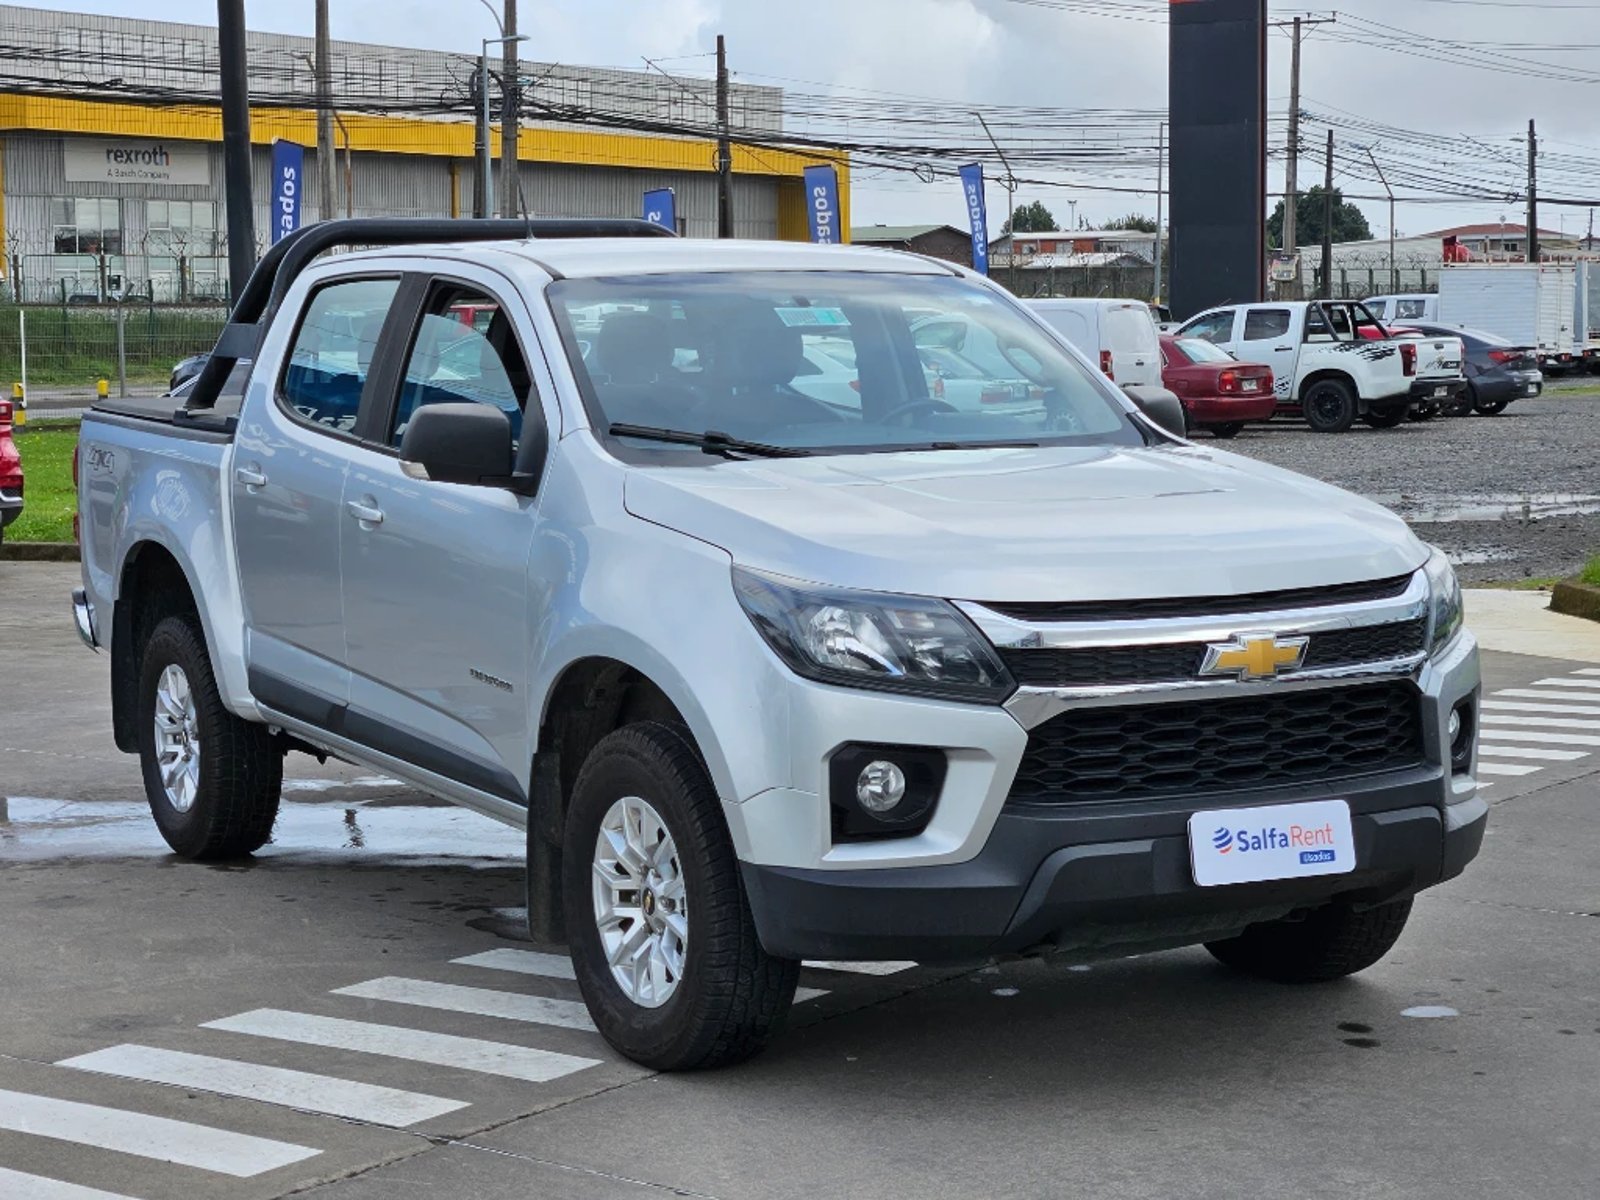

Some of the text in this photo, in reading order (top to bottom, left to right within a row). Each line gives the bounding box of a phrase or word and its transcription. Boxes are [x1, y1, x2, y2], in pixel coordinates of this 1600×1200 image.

[106, 145, 170, 166] rexroth
[107, 169, 113, 177] A
[138, 169, 170, 180] Company
[1236, 823, 1334, 852] SalfaRent
